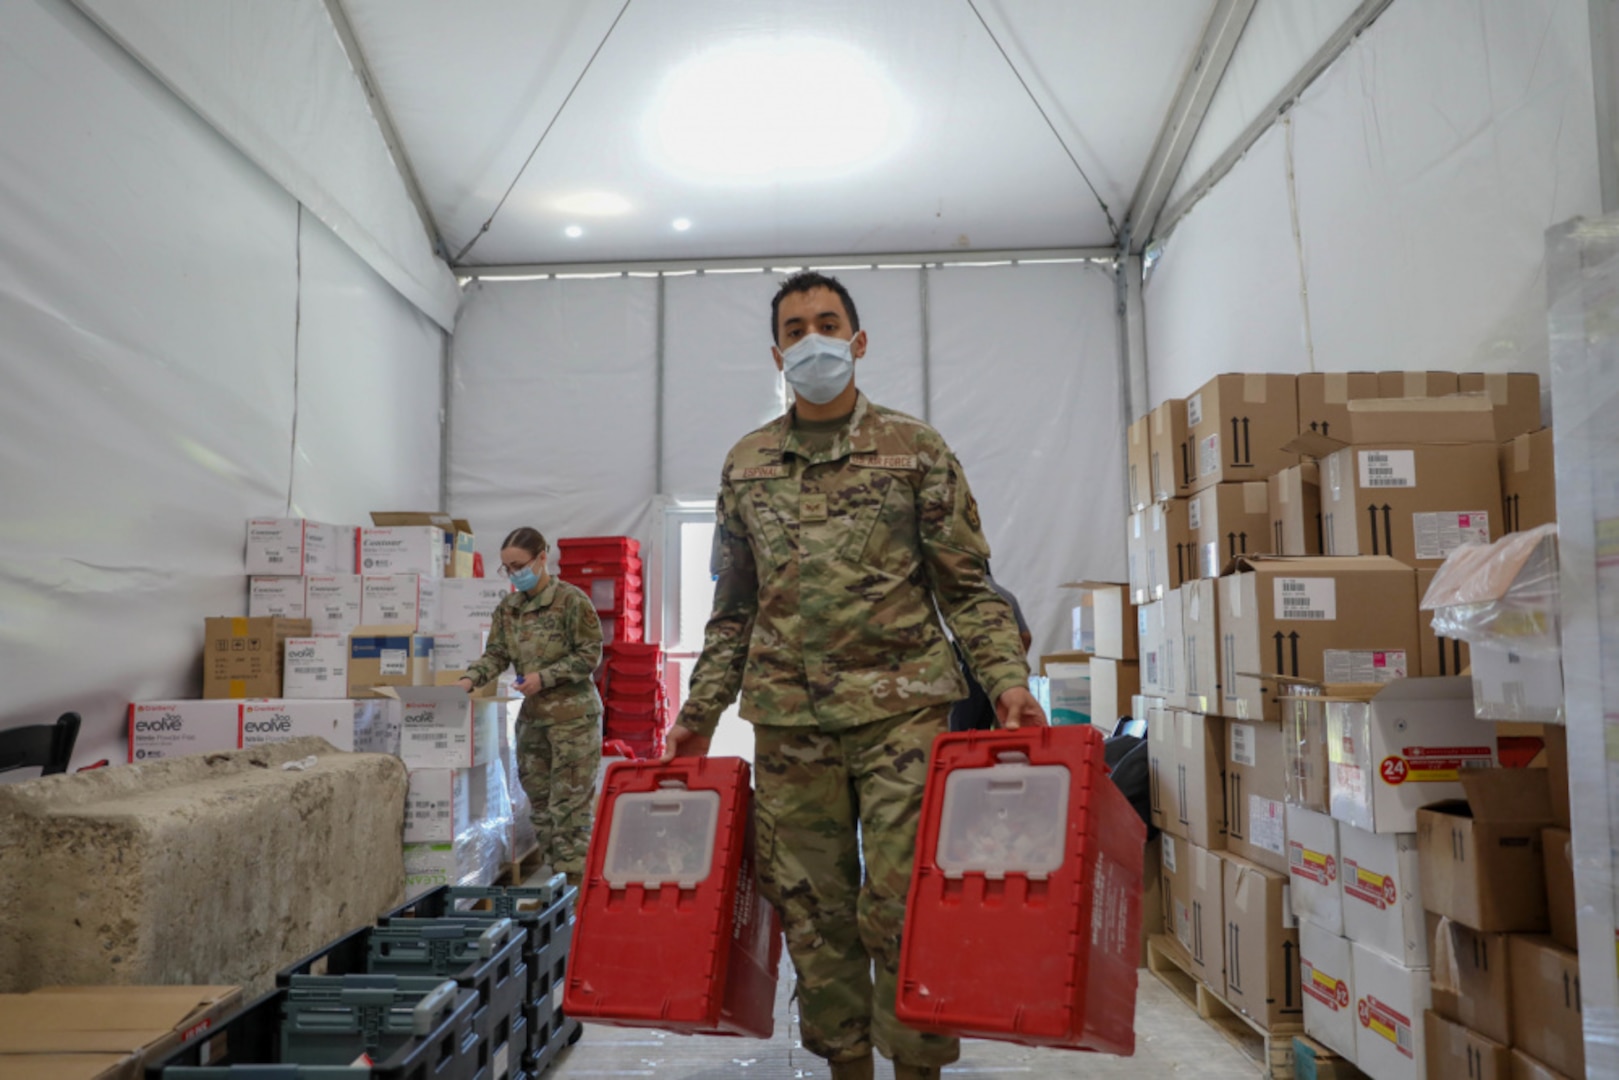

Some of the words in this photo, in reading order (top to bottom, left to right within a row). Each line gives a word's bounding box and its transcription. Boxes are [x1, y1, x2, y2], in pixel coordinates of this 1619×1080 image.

[868, 457, 882, 466] AIR
[884, 457, 912, 467] FORCE
[135, 717, 182, 732] evolve
[244, 718, 292, 733] evolve
[404, 713, 434, 723] evolve
[1383, 760, 1405, 775] 24
